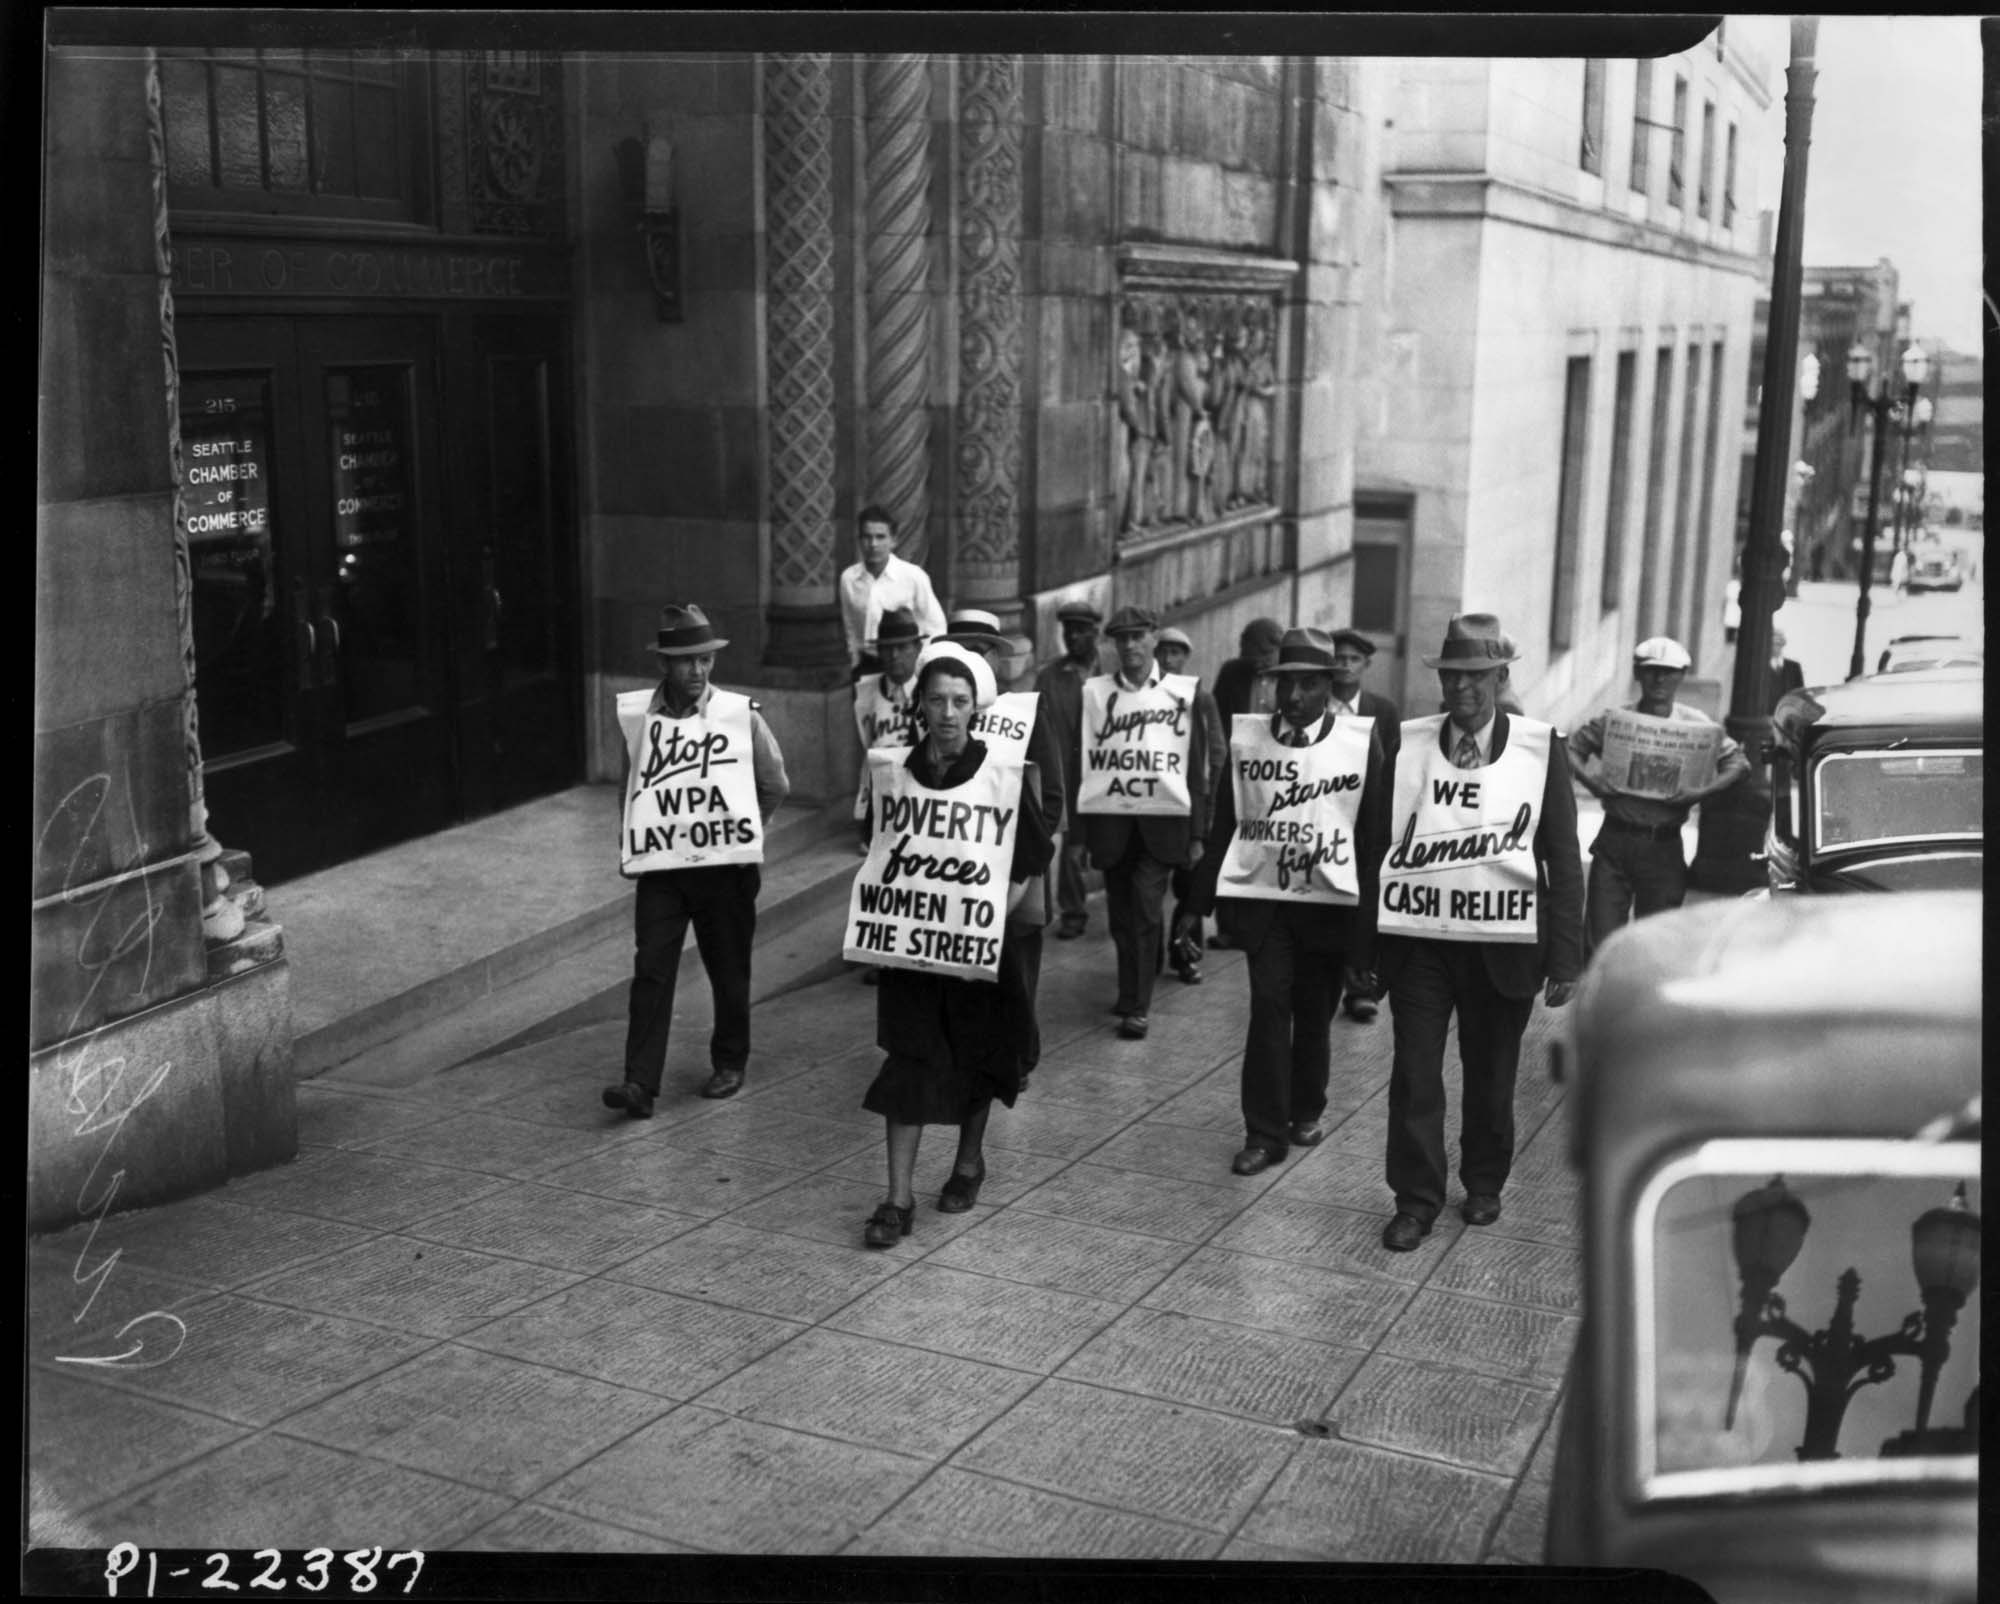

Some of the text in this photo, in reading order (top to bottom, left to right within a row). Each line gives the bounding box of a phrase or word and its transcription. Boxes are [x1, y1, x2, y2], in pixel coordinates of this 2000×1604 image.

[328, 251, 521, 295] COMMERCE
[192, 440, 253, 457] SEATTLE
[189, 462, 259, 485] CHAMBER
[217, 491, 233, 504] OF
[187, 508, 266, 534] COMMERCE
[974, 711, 1028, 740] HERS
[1094, 692, 1186, 745] Support
[641, 720, 729, 786] Stop
[1088, 749, 1180, 774] WAGNER
[1239, 760, 1299, 782] FOOLS
[655, 785, 729, 817] WPA
[1106, 777, 1159, 798] ACT
[1267, 772, 1361, 816] starve
[1432, 779, 1481, 808] WE
[630, 817, 755, 855] LAY-OFFS
[880, 794, 1013, 846] POVERTY
[1238, 819, 1314, 843] WORKERS
[1388, 802, 1532, 870] demand
[882, 834, 991, 885] forces
[1276, 829, 1349, 890] fight
[860, 884, 994, 928] WOMEN TO
[1382, 881, 1534, 921] CASH RELIEF
[855, 920, 999, 966] THE STREETS
